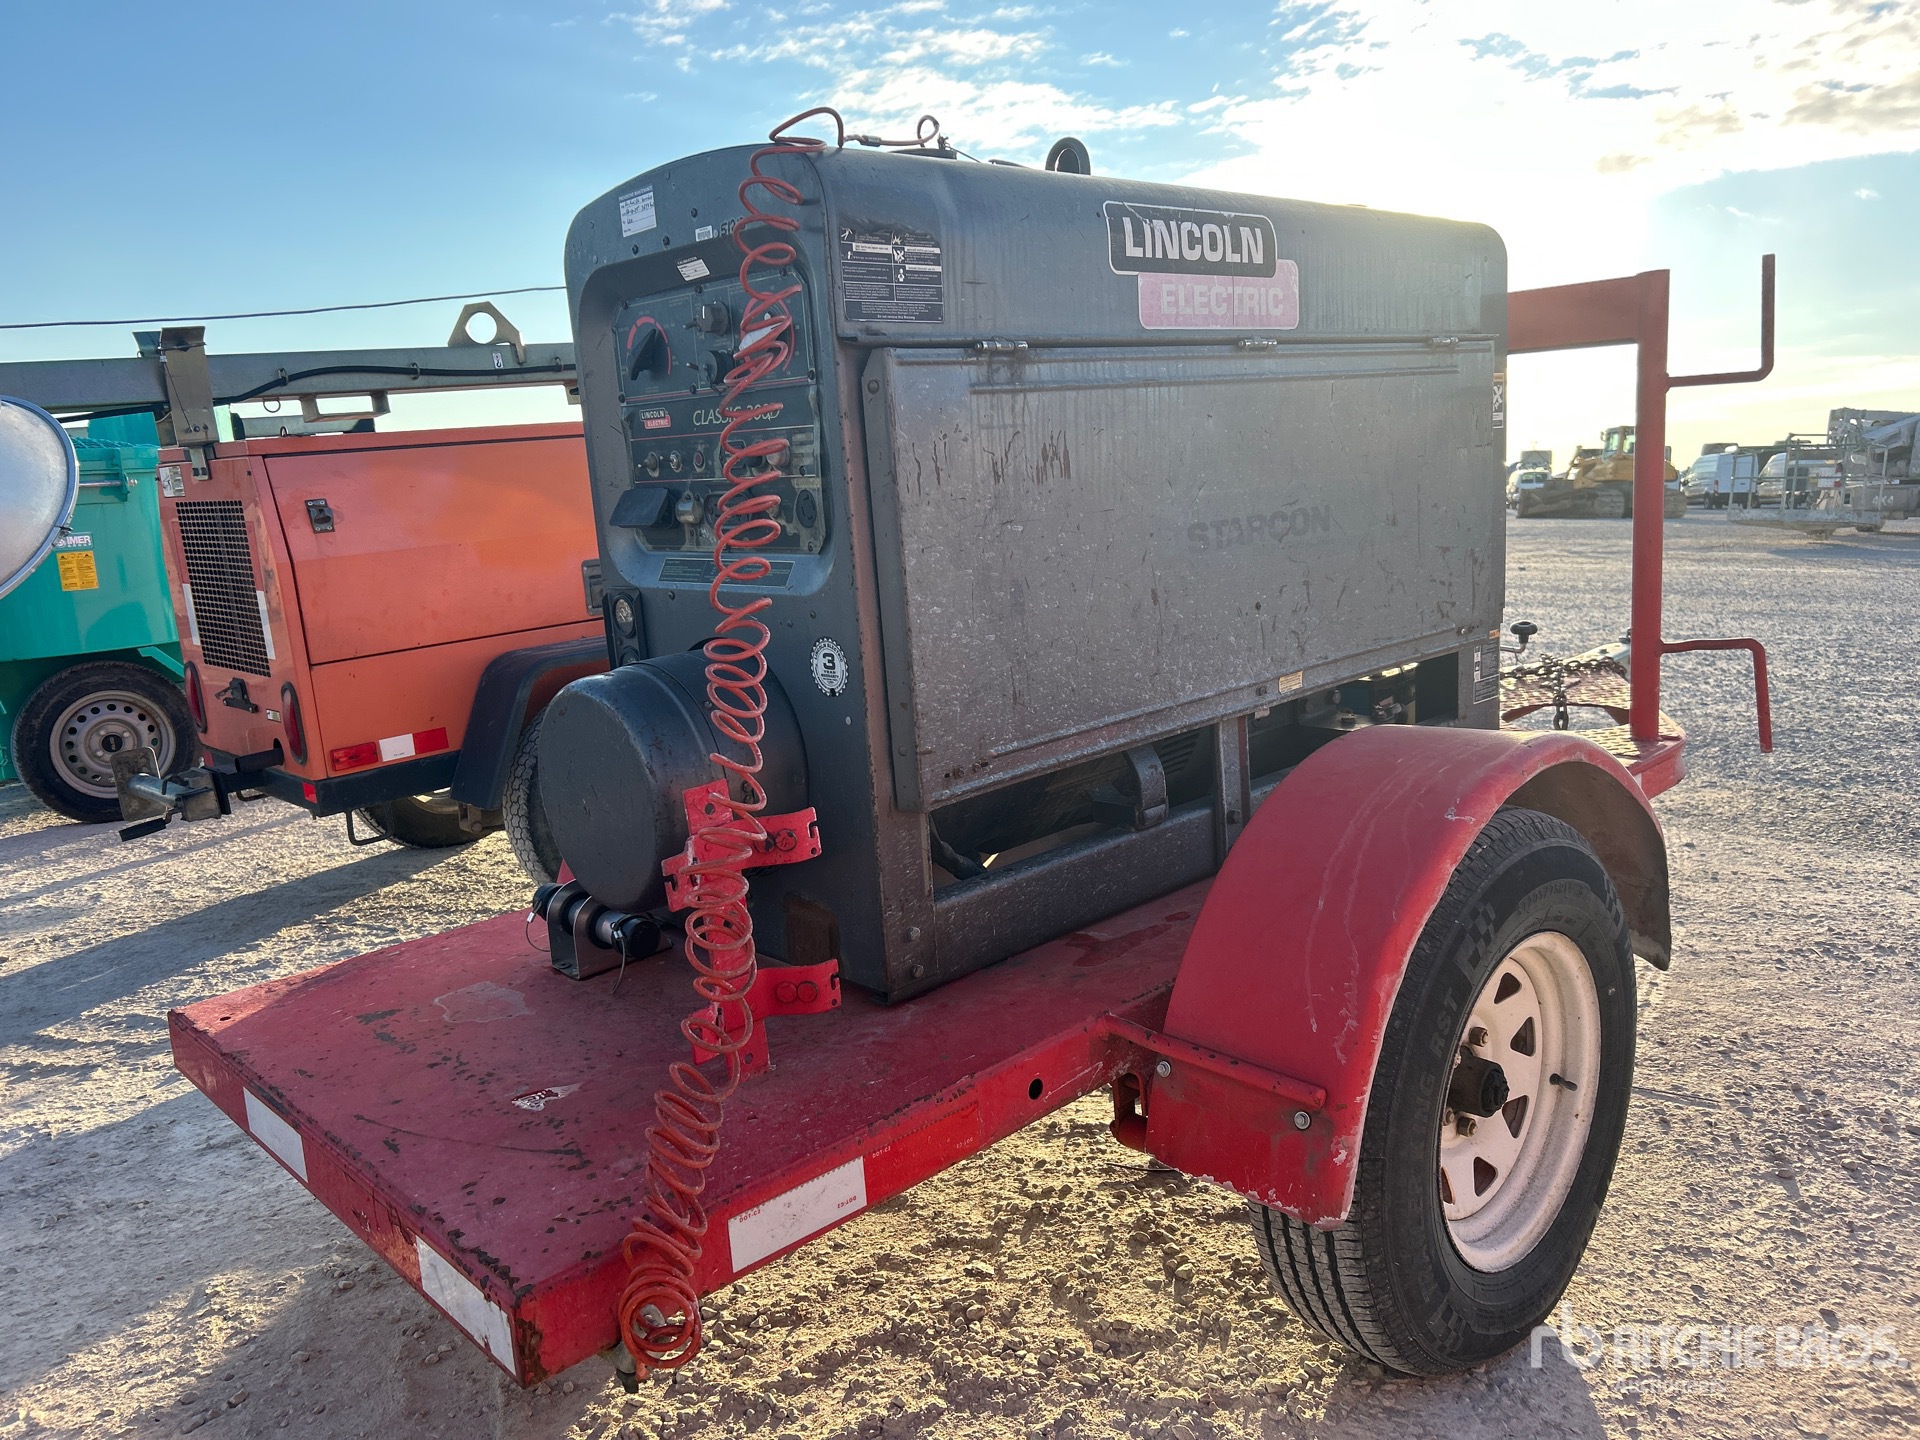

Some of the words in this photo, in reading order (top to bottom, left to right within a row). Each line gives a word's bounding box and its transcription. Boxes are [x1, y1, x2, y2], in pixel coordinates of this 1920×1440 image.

[1122, 216, 1264, 264] LINCOLN
[1161, 283, 1284, 316] ELECTRIC
[641, 409, 664, 419] LINCOLN
[647, 418, 669, 427] ELECTRIC
[1187, 504, 1331, 551] STARCON
[66, 535, 91, 544] IMER
[822, 652, 836, 670] 3
[1407, 1070, 1438, 1160] KING
[1427, 986, 1458, 1059] RST
[739, 1208, 761, 1224] DOT-C2
